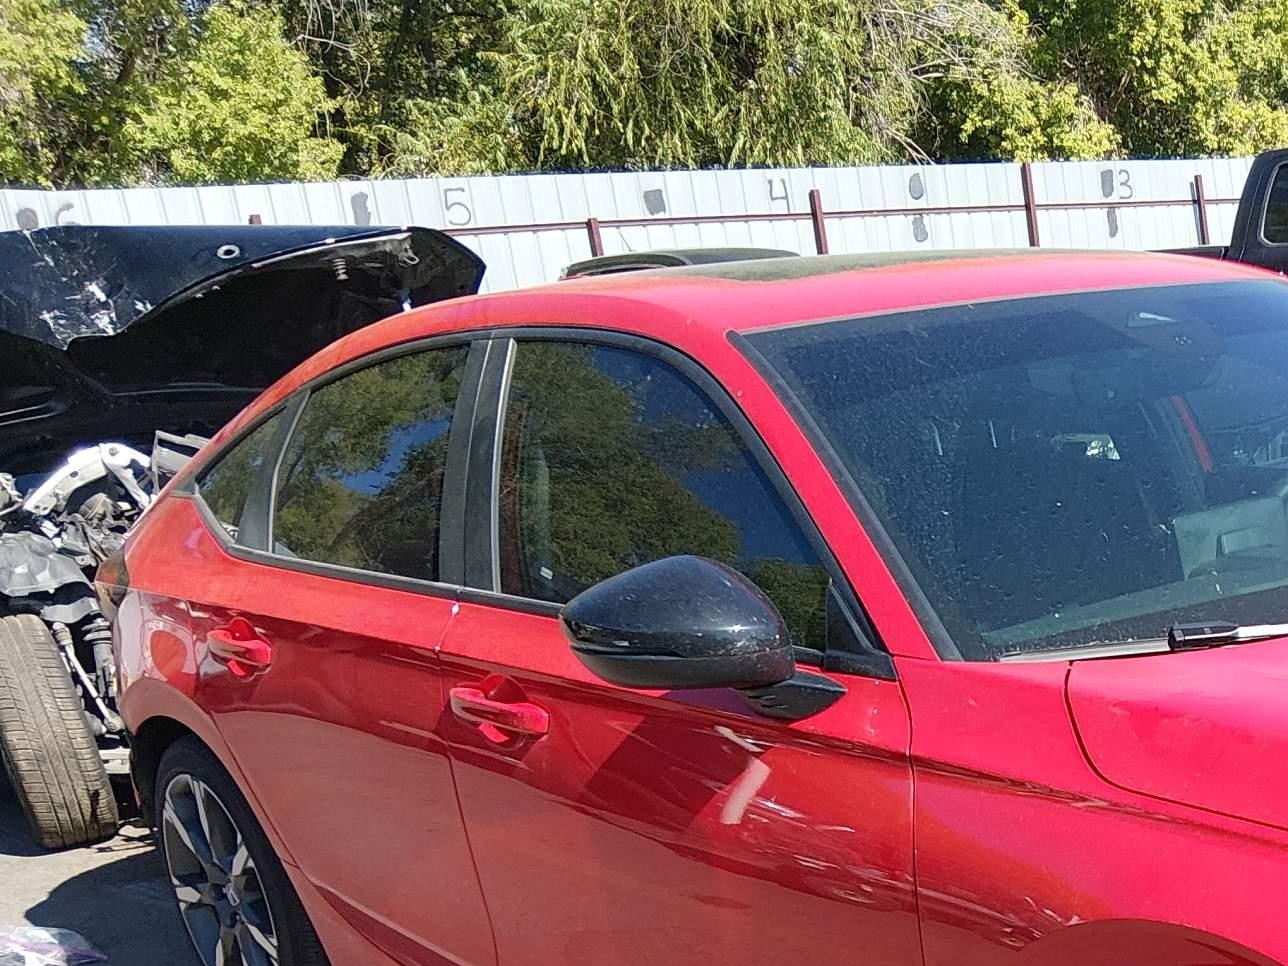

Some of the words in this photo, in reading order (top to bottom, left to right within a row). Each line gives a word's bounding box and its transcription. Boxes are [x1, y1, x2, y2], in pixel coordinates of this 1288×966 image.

[766, 178, 790, 214] 4
[1118, 169, 1134, 200] 3
[442, 187, 472, 226] 5
